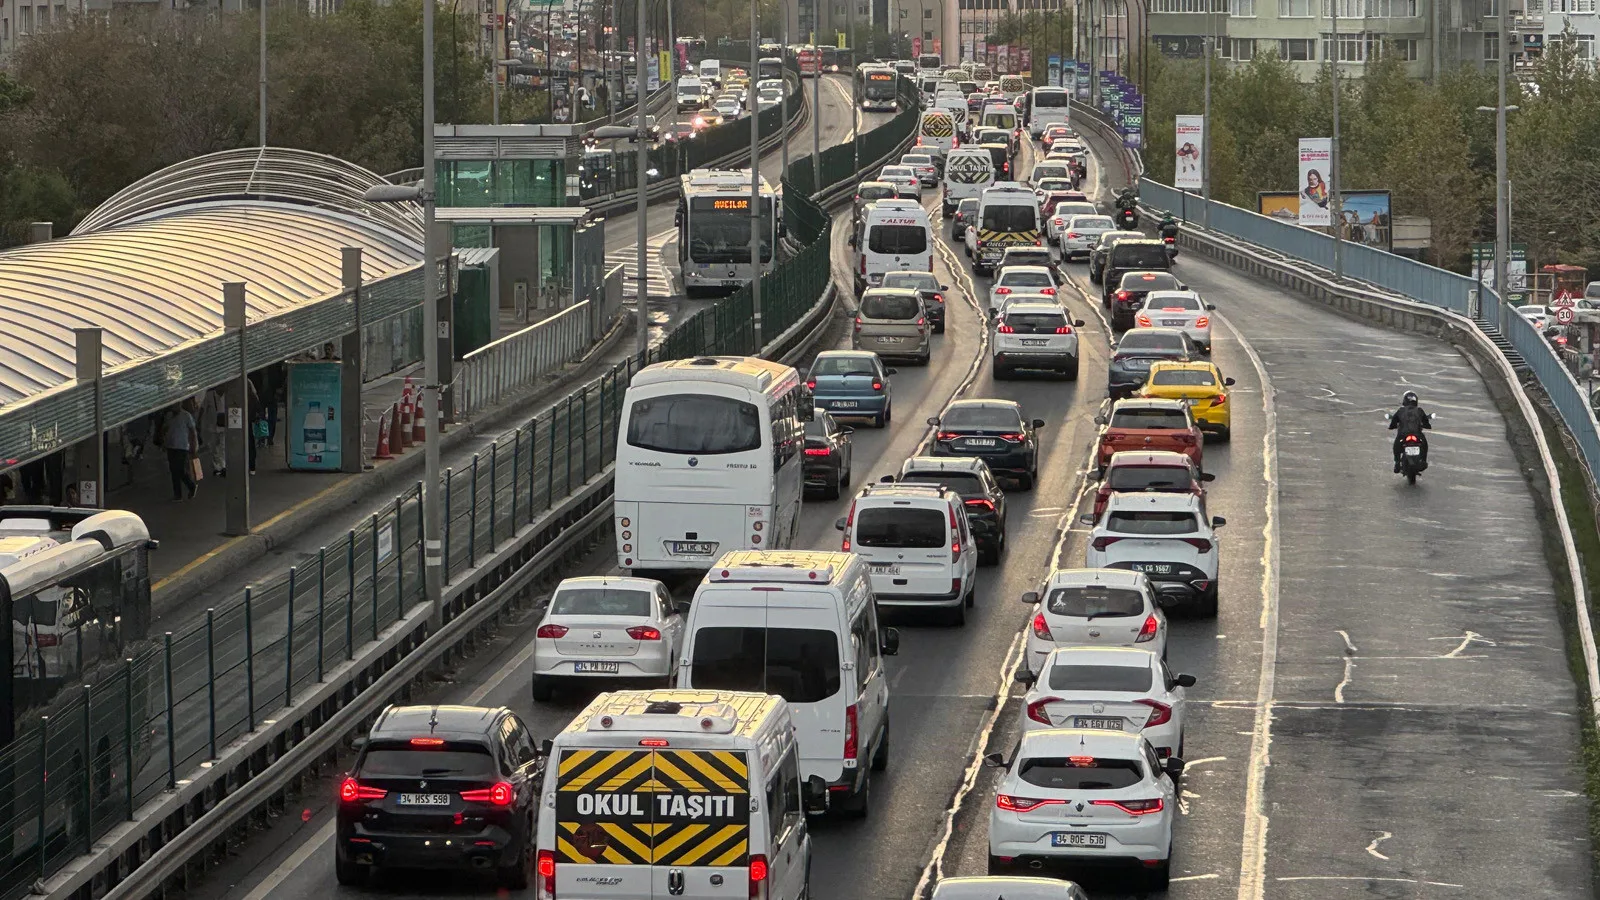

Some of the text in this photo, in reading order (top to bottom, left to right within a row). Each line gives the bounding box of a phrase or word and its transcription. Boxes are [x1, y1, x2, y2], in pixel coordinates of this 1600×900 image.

[1560, 311, 1571, 319] 30
[1079, 719, 1088, 729] 34
[402, 794, 448, 804] 34 HSS 598
[576, 793, 734, 820] OKUL TAŞITI
[1057, 834, 1067, 843] 34
